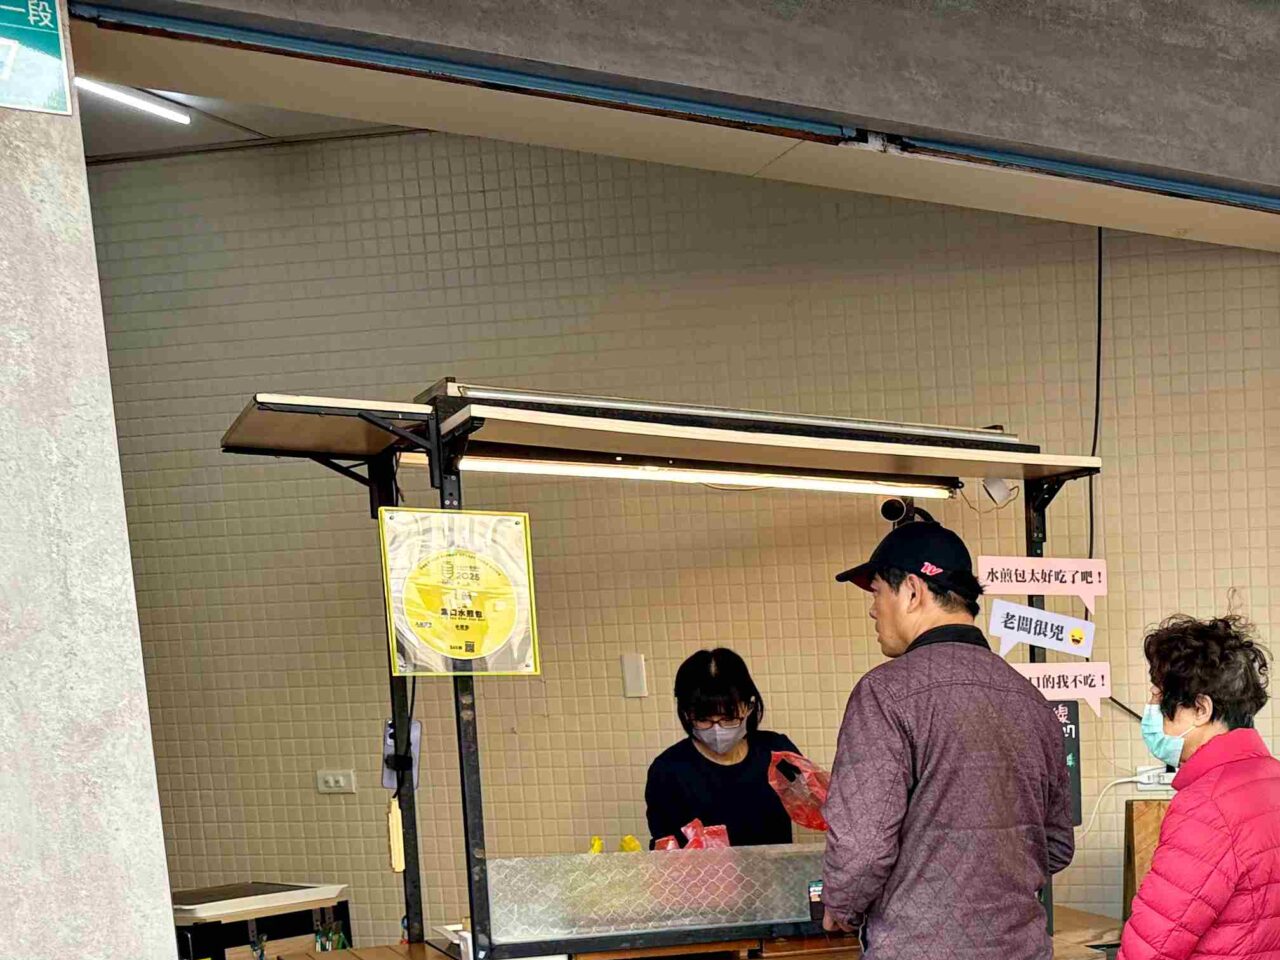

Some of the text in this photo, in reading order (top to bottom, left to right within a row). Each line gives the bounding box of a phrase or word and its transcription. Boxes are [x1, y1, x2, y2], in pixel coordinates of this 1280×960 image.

[986, 567, 1102, 584] 水煎包太好吃了吧！
[1001, 611, 1065, 642] 老闆很兇
